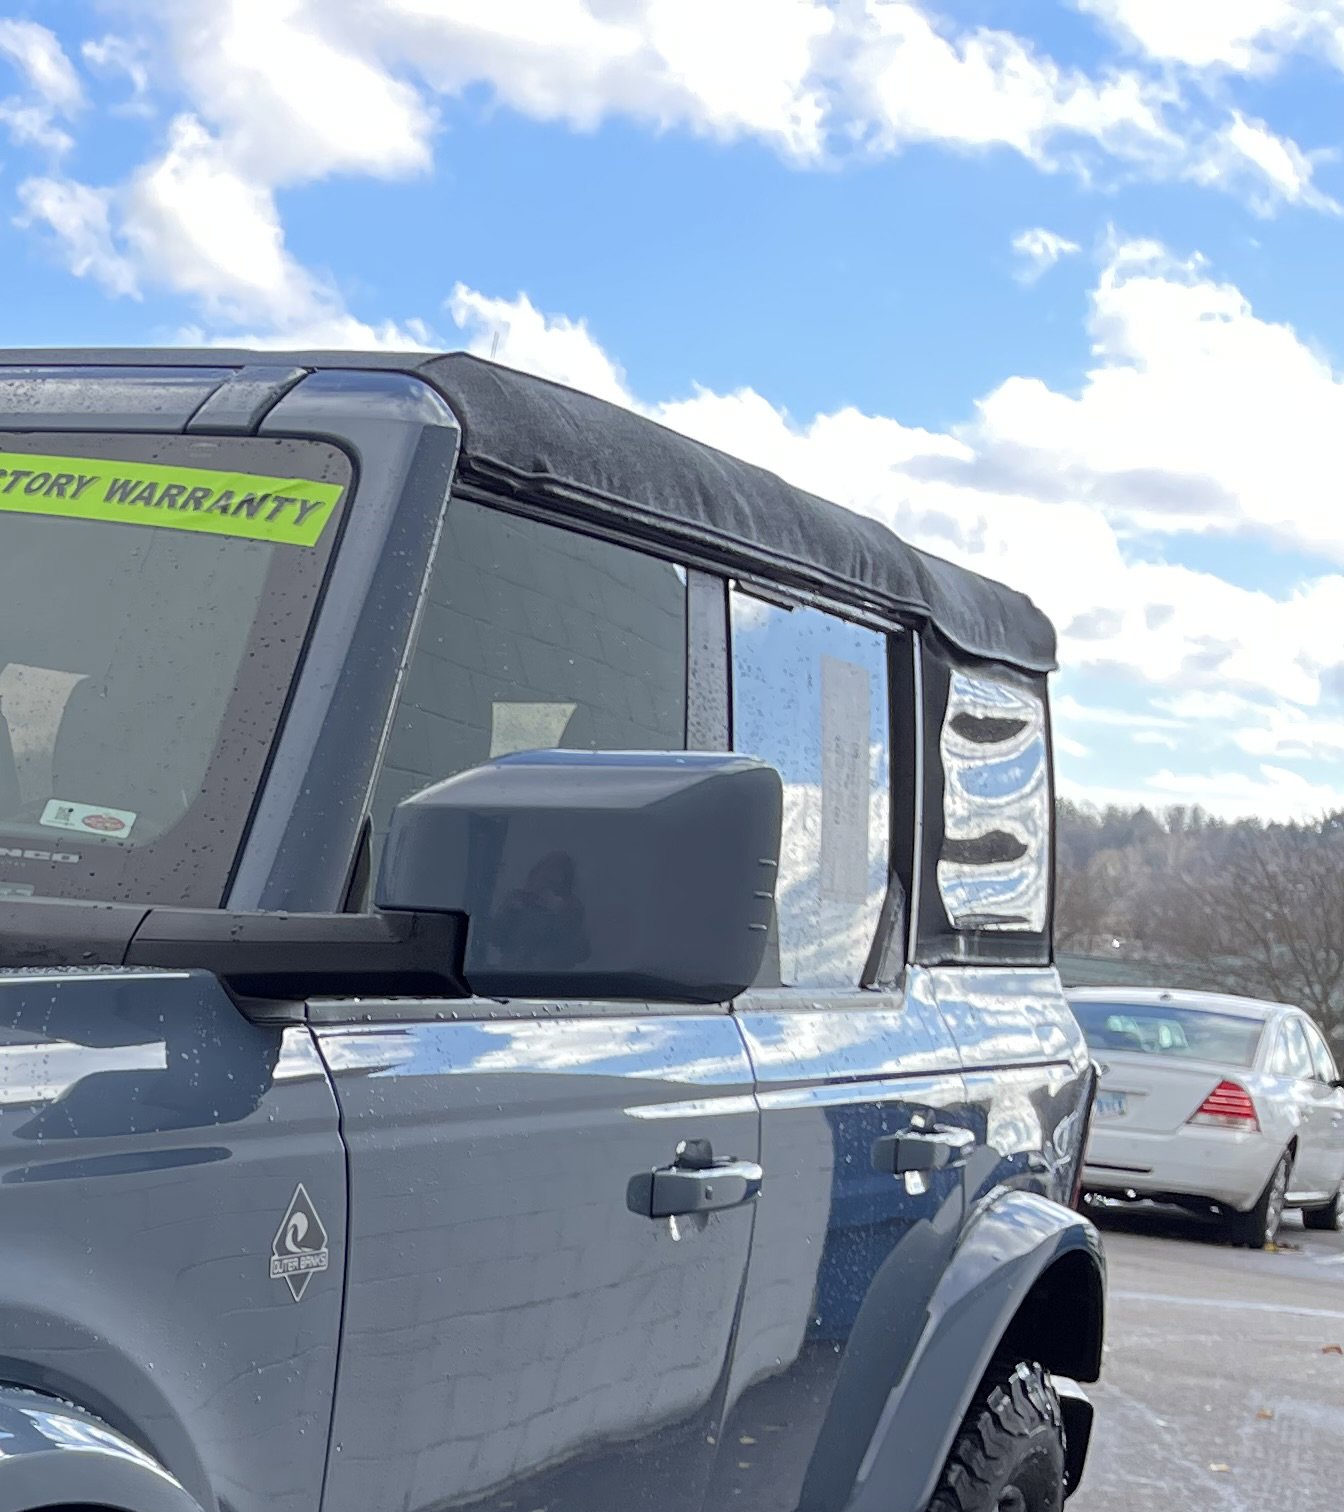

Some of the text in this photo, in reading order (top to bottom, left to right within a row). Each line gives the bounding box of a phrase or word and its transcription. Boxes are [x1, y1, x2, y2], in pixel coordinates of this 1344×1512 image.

[103, 478, 326, 526] WARRANTY
[273, 1253, 326, 1273] OUTER BANKS
